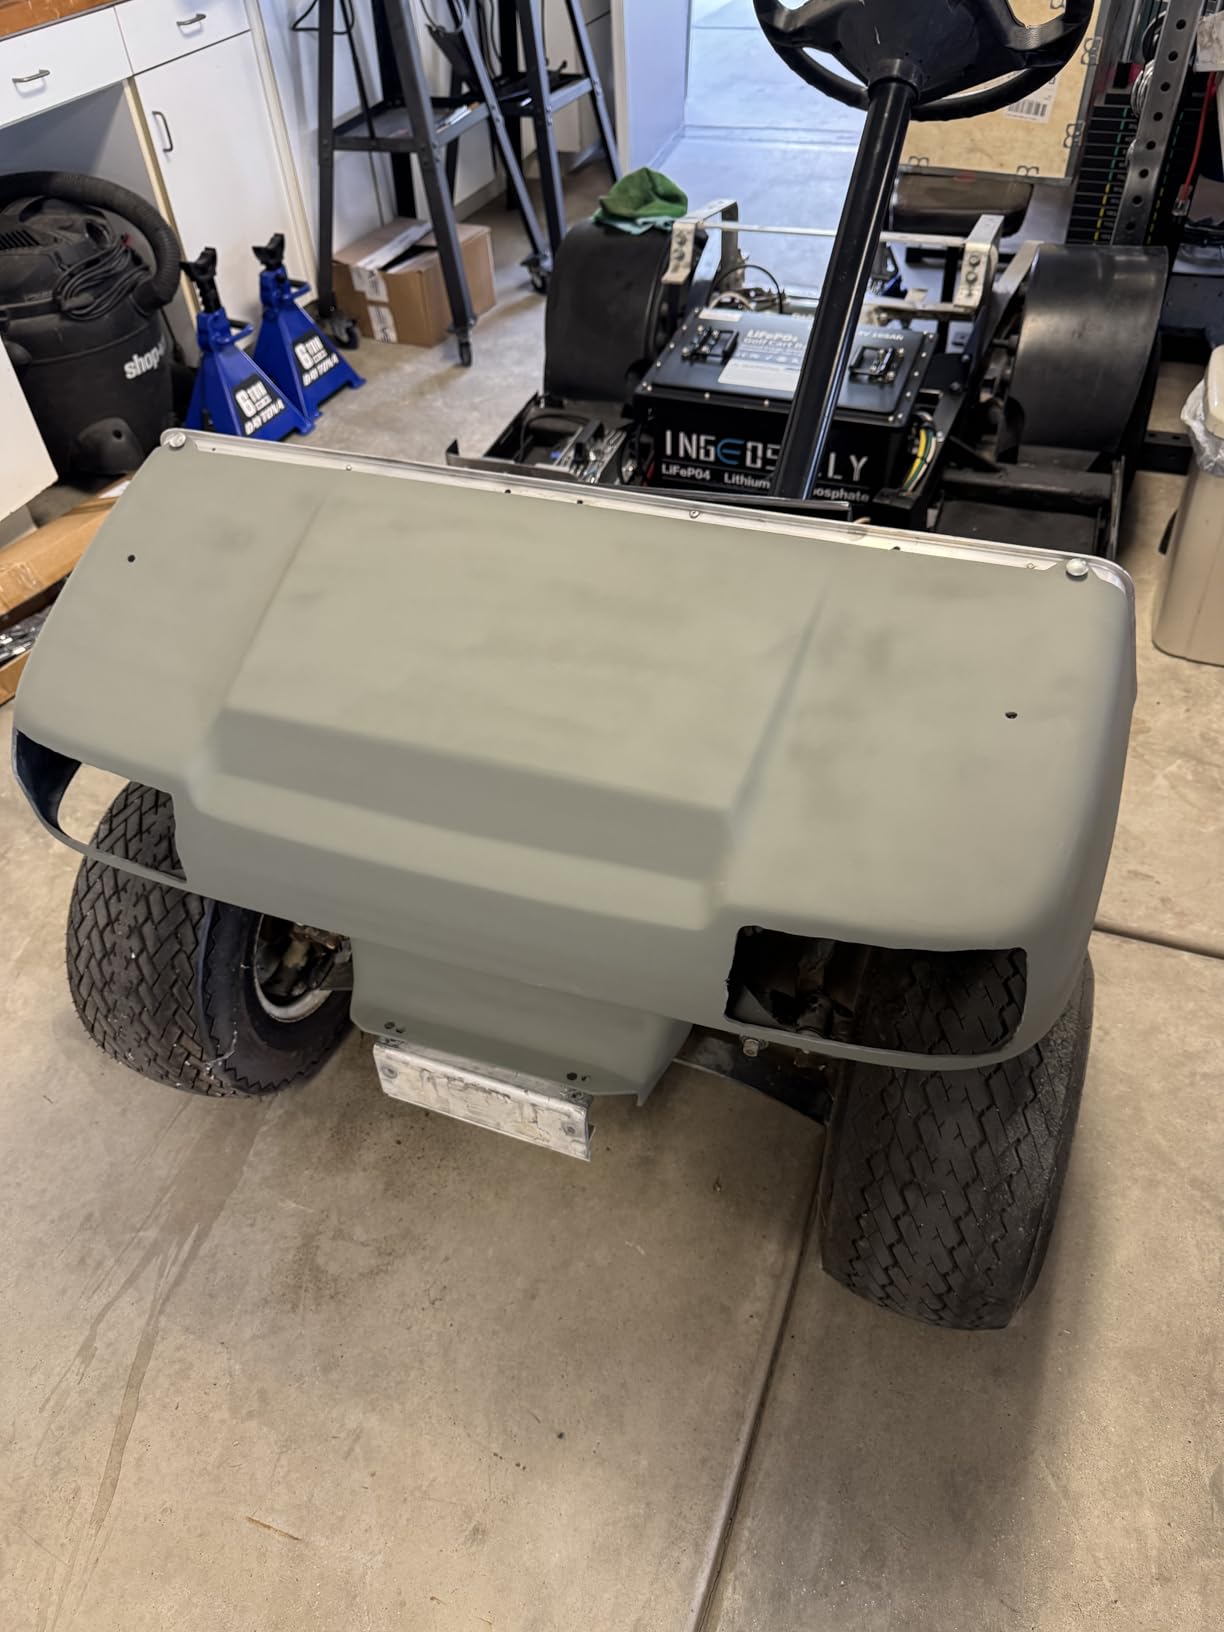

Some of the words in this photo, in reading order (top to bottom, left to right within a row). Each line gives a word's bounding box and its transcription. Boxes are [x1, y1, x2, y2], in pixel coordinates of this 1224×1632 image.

[294, 343, 314, 370] 6
[235, 389, 257, 418] 6
[724, 472, 770, 489] Lithium
[813, 488, 870, 502] osphate
